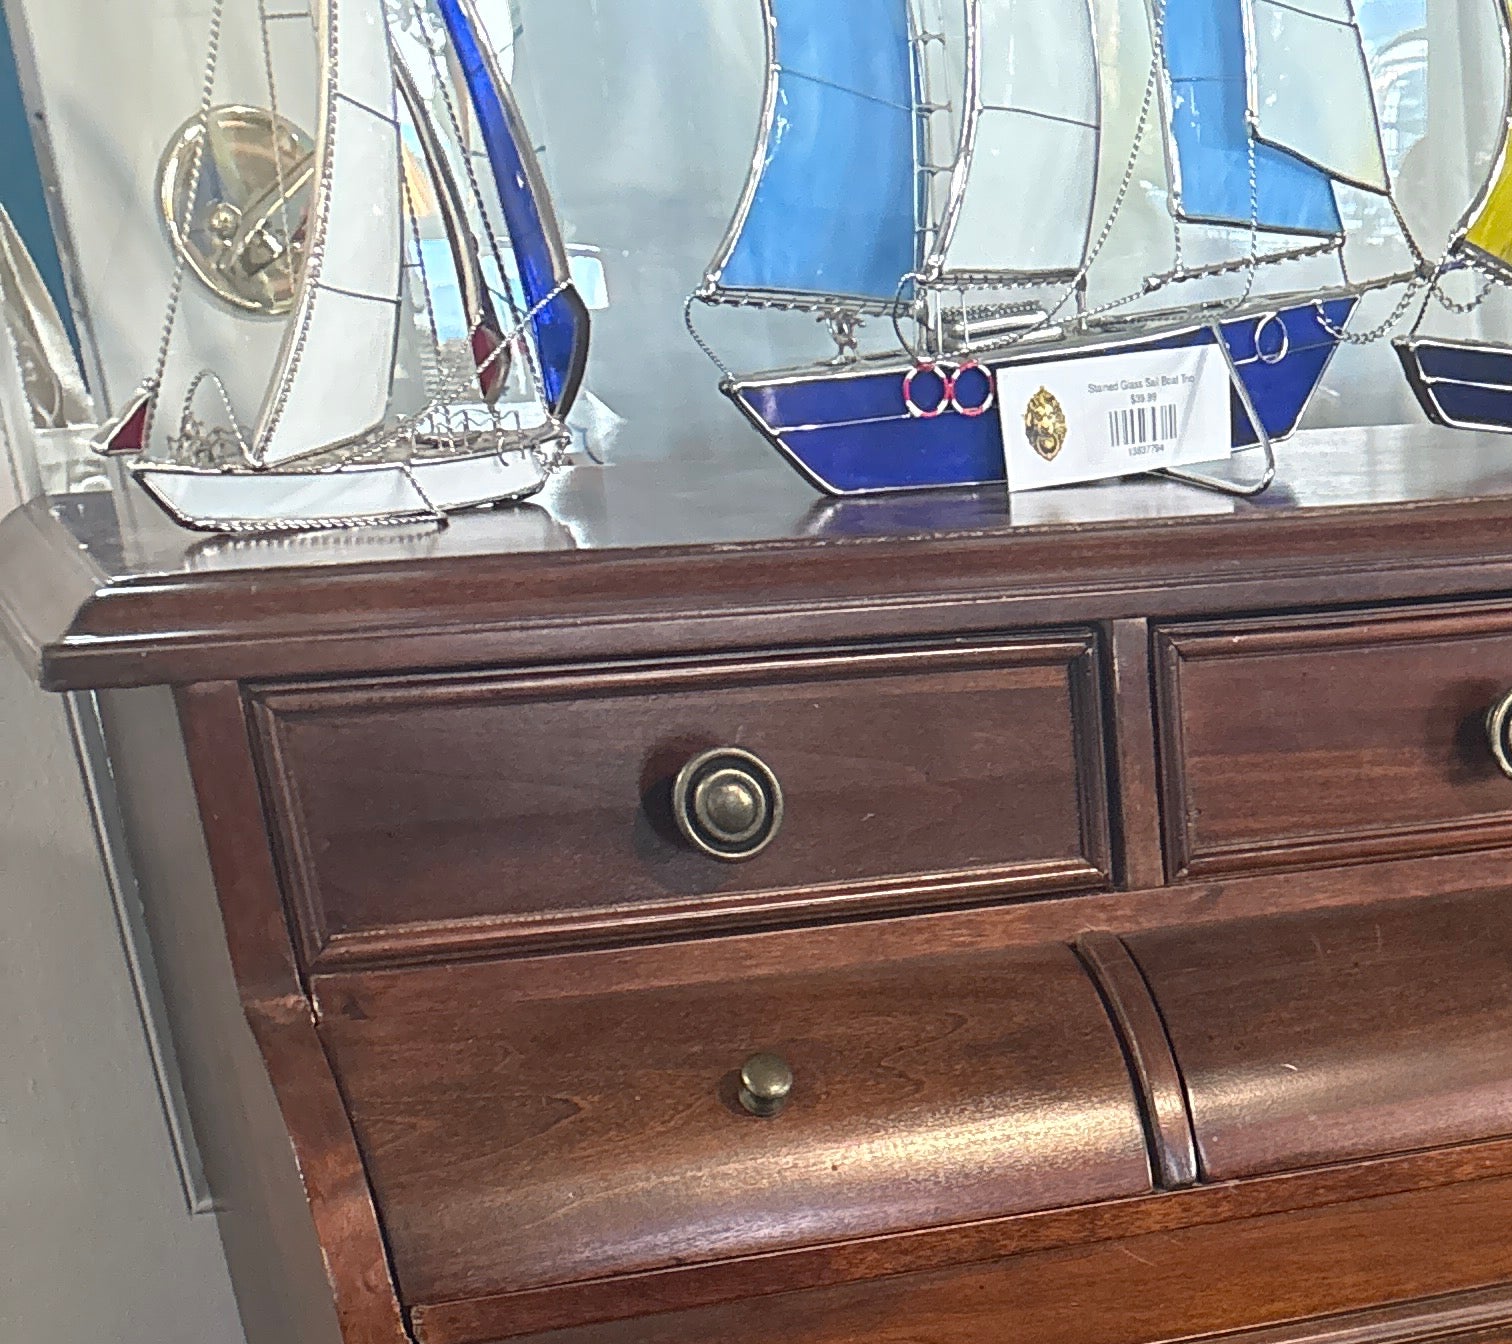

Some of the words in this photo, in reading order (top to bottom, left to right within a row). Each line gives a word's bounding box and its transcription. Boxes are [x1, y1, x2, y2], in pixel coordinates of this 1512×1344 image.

[1120, 379, 1143, 391] Glass
[1144, 377, 1159, 388] Sail
[1161, 375, 1179, 387] Boat
